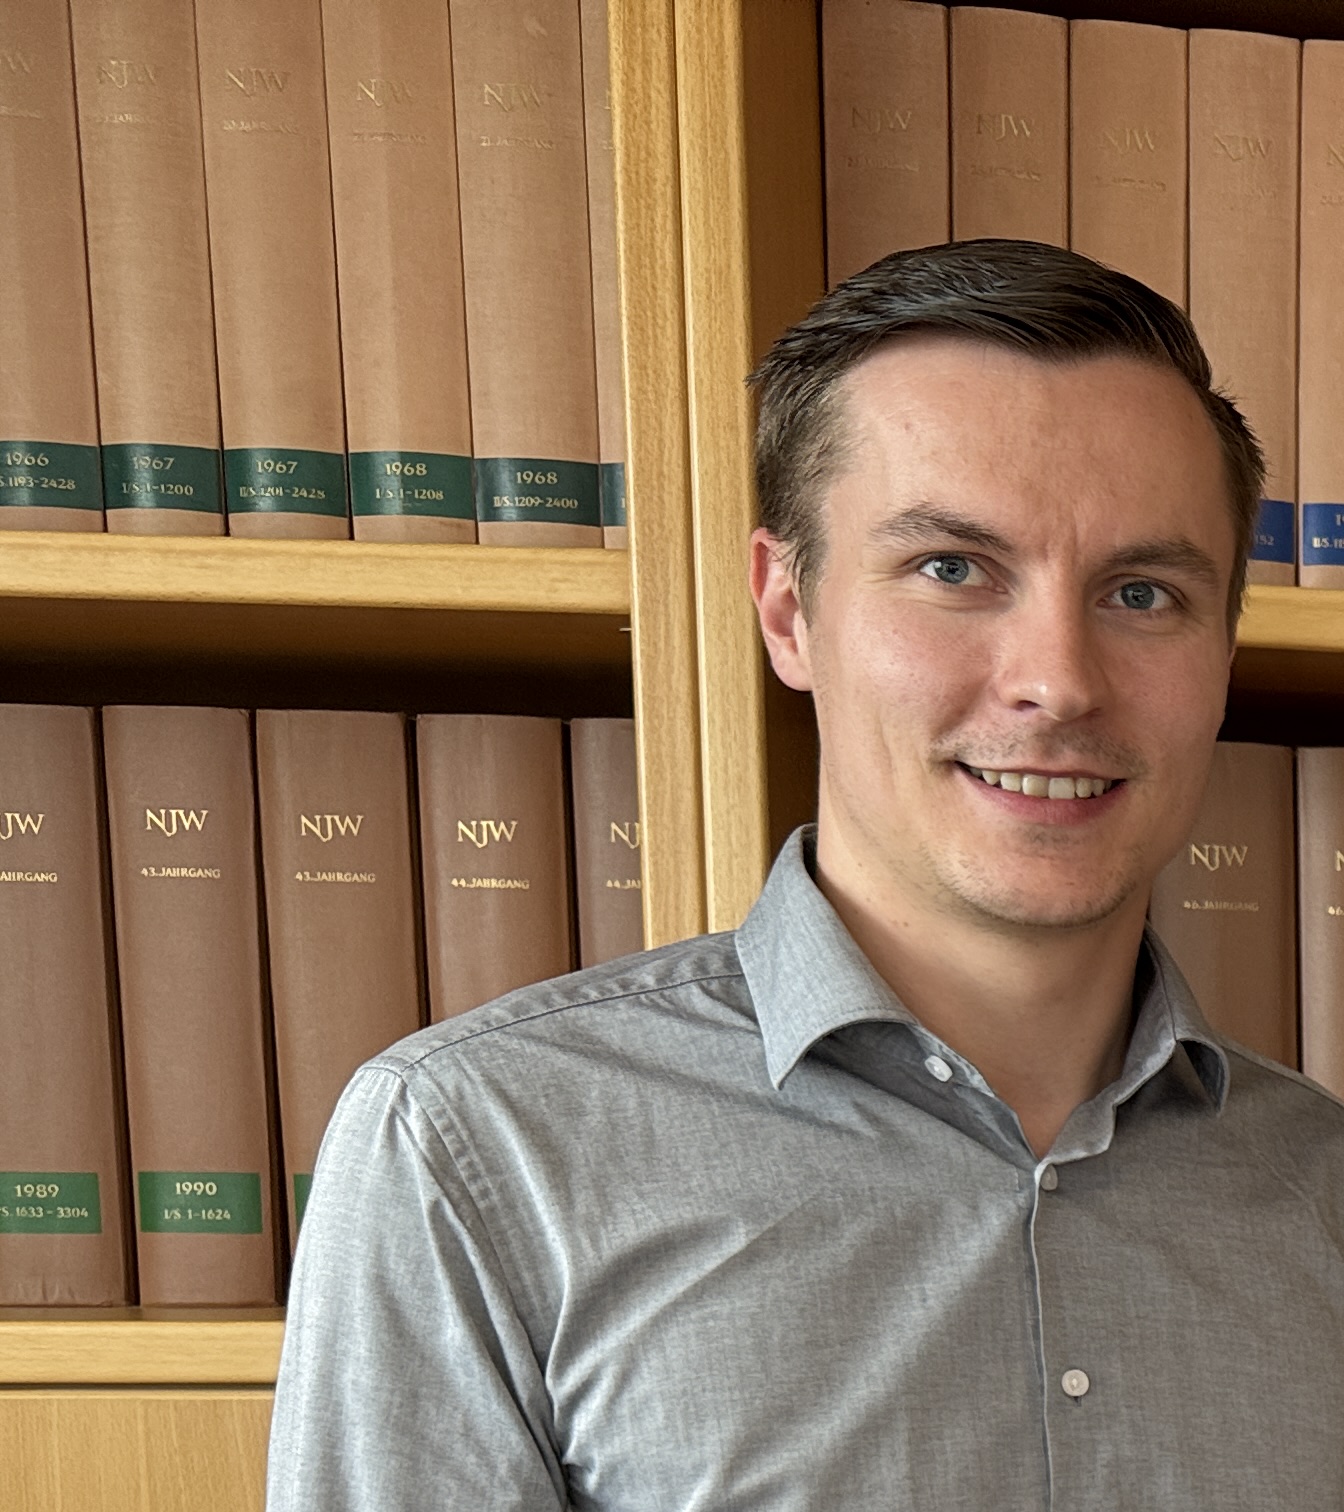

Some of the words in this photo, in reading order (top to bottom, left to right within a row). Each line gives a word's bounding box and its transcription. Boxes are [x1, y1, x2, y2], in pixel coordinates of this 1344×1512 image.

[5, 451, 50, 467] 1966
[133, 456, 175, 470] 1967
[255, 460, 298, 475] 1967
[385, 462, 427, 477] 1968
[516, 470, 558, 485] 1968
[0, 811, 45, 840] JW
[145, 809, 209, 837] NJW
[300, 814, 364, 842] NJW
[457, 820, 518, 848] NJW
[610, 821, 641, 849] NJ
[1190, 843, 1248, 871] NJW
[14, 1183, 59, 1198] 1989
[175, 1181, 217, 1197] 1990
